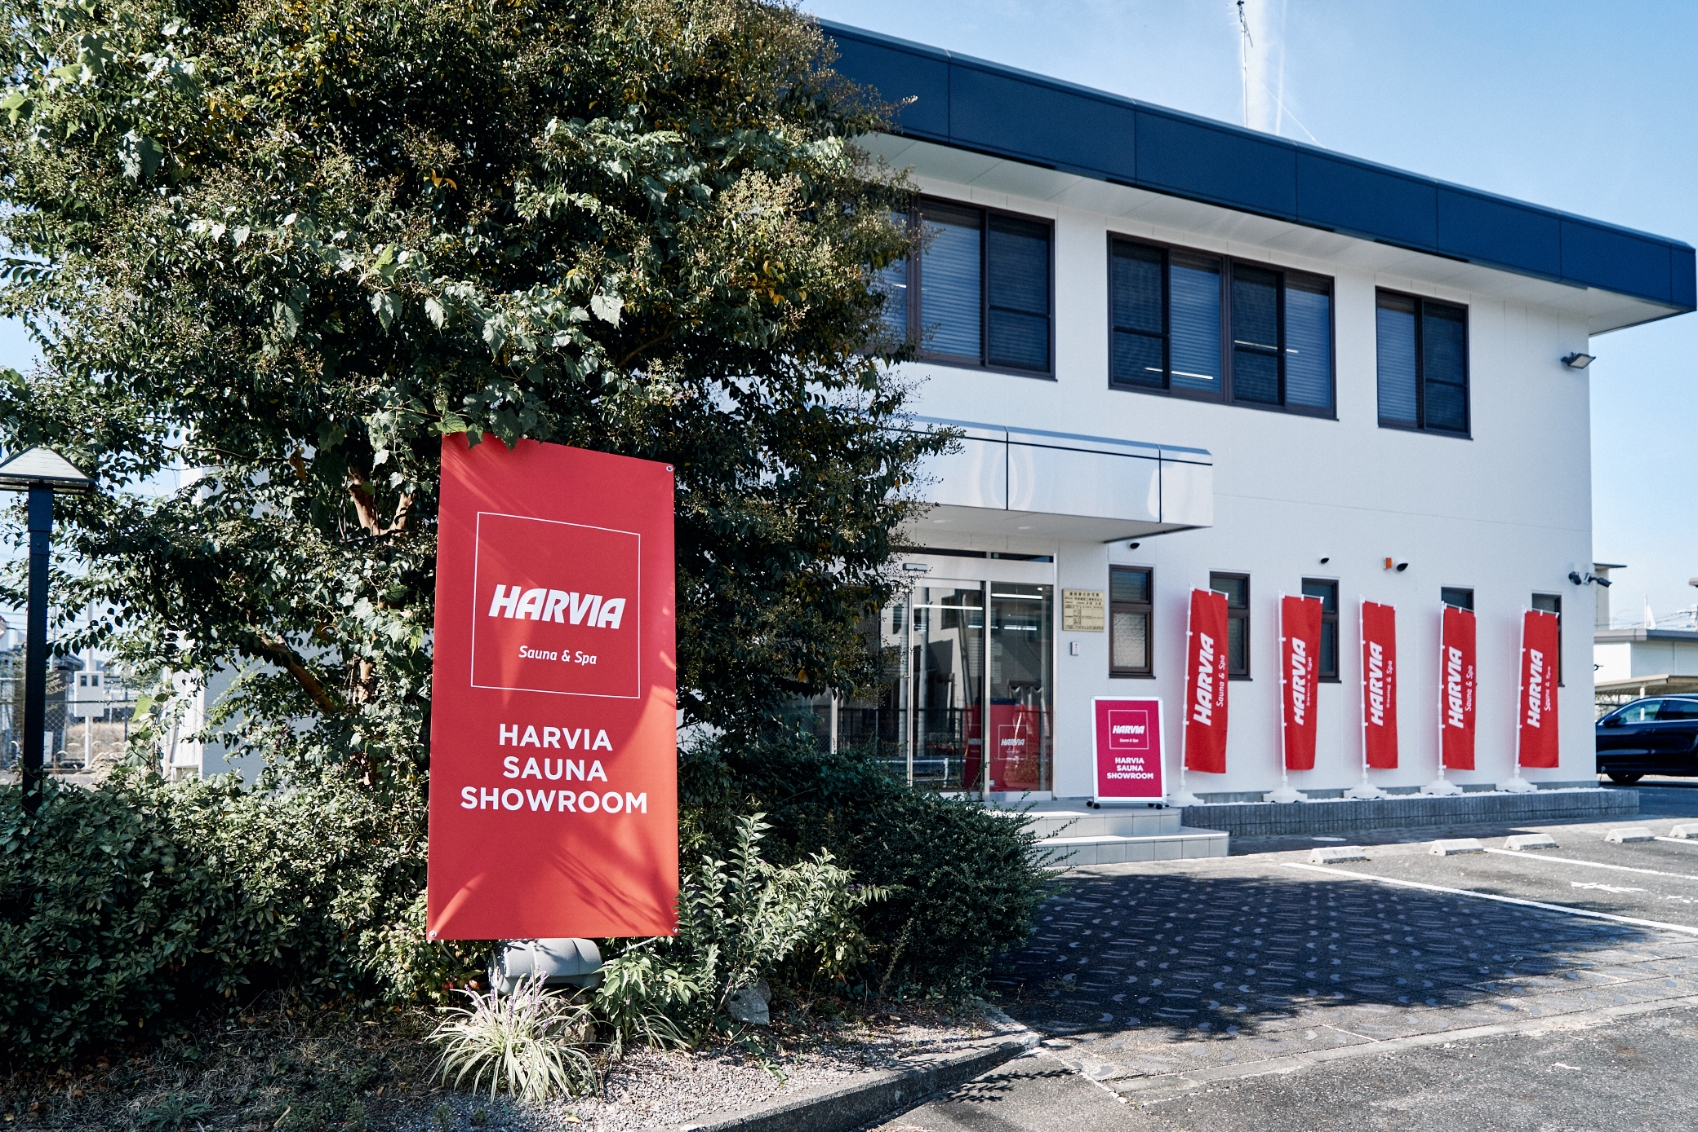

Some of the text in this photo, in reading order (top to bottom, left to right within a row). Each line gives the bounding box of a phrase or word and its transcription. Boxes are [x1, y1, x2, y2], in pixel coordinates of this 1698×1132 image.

[488, 584, 626, 629] HARVIA
[518, 646, 597, 666] Sauna & Spa
[1218, 654, 1226, 670] Spa
[1192, 632, 1214, 726] HARVIA
[1291, 637, 1306, 726] HARVIA
[1369, 641, 1384, 727] HARVIA
[1466, 665, 1474, 679] Spa
[1215, 682, 1225, 707] Sauna
[1447, 646, 1464, 729] HARVIA
[1464, 689, 1473, 712] Sauna
[1526, 648, 1544, 729] HARVIA
[499, 724, 613, 751] HARVIA
[1112, 725, 1145, 734] HARVIA
[502, 757, 608, 782] SAUNA
[460, 787, 647, 814] SHOWROOM
